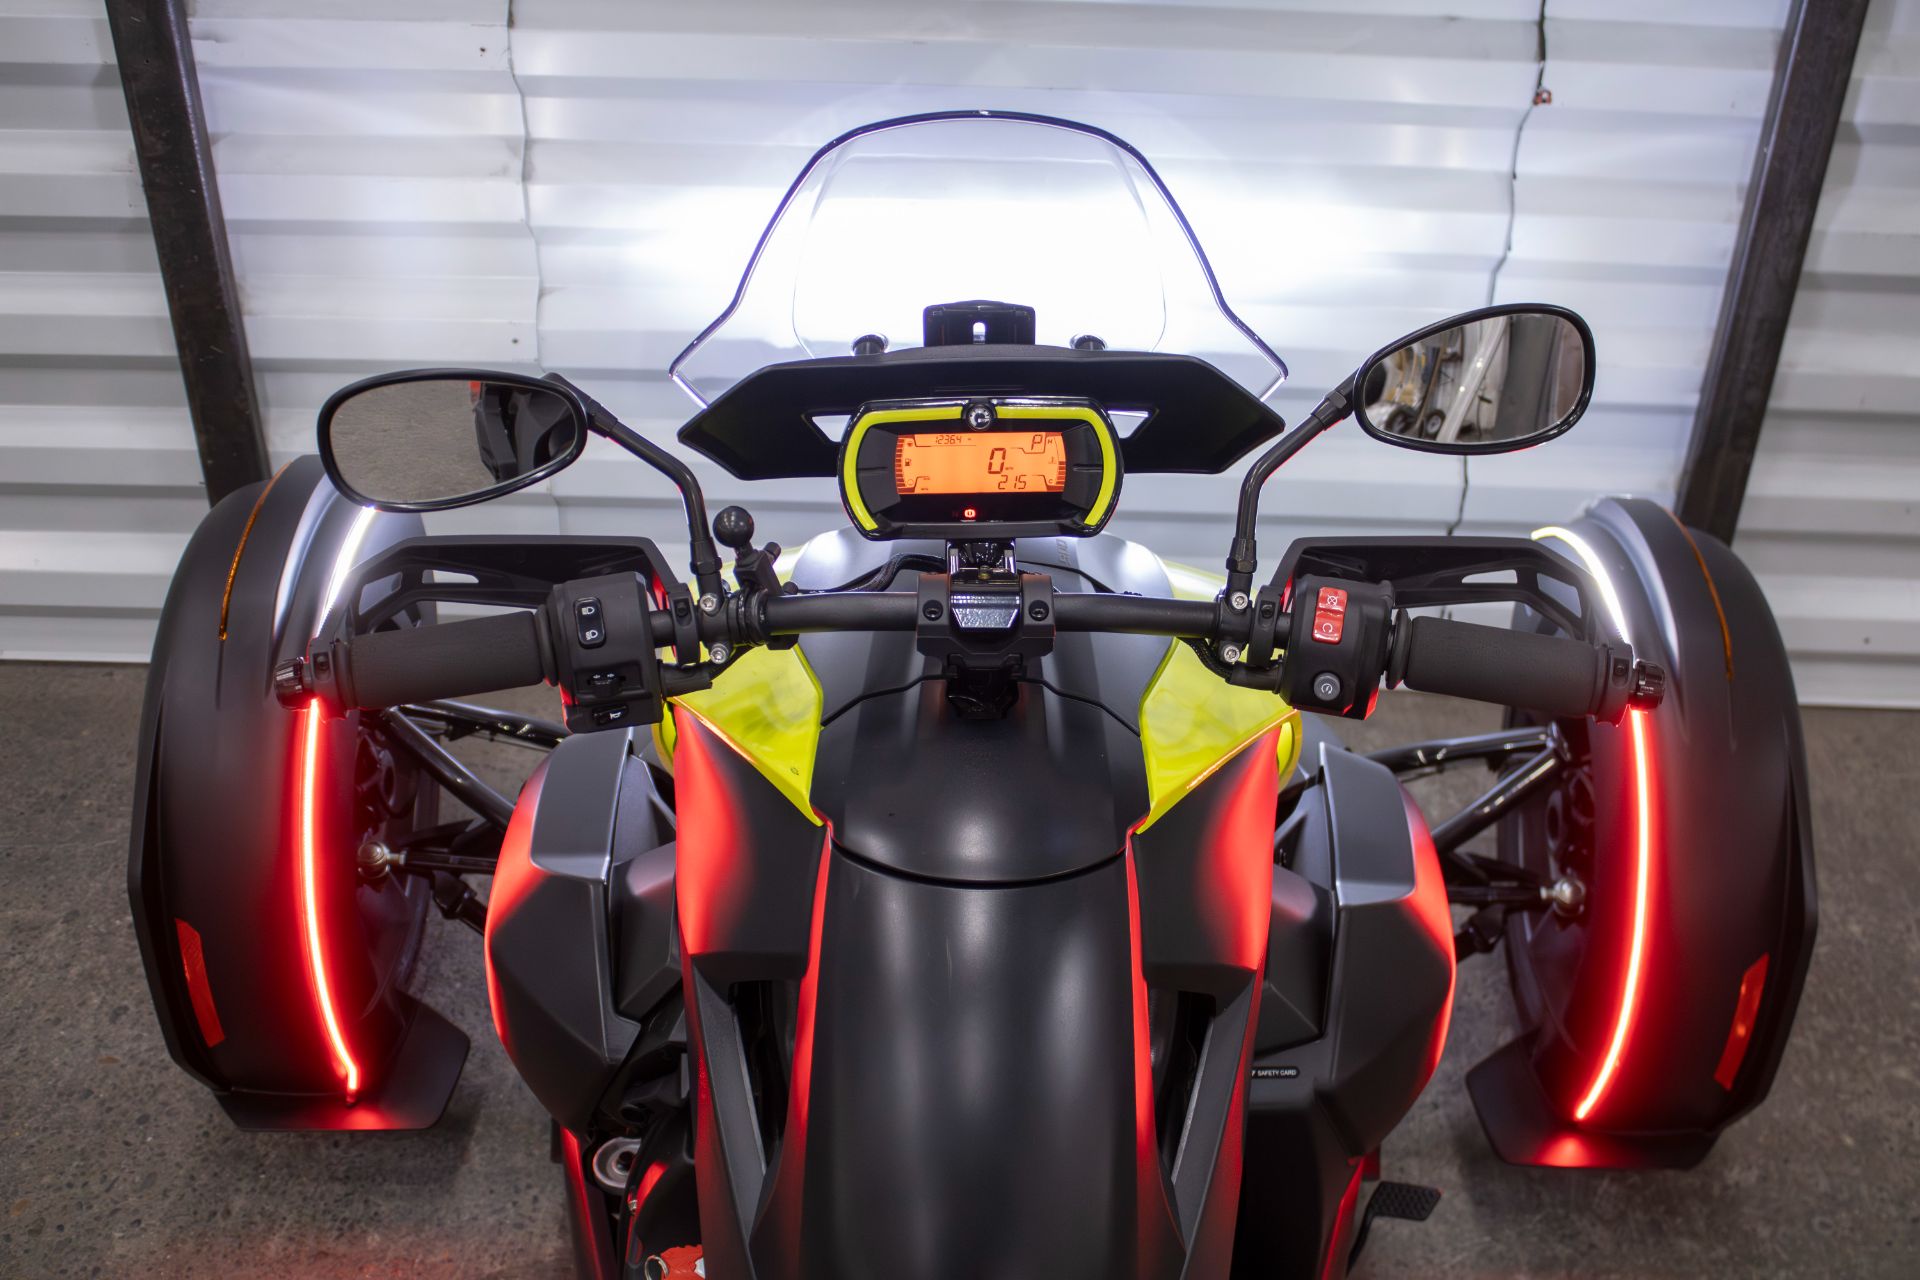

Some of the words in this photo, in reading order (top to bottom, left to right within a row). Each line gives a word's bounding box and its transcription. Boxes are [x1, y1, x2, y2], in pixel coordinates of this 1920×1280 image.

[1031, 434, 1043, 451] P
[988, 448, 1006, 474] 0
[998, 475, 1027, 490] 215
[1258, 1069, 1279, 1077] SAFETY
